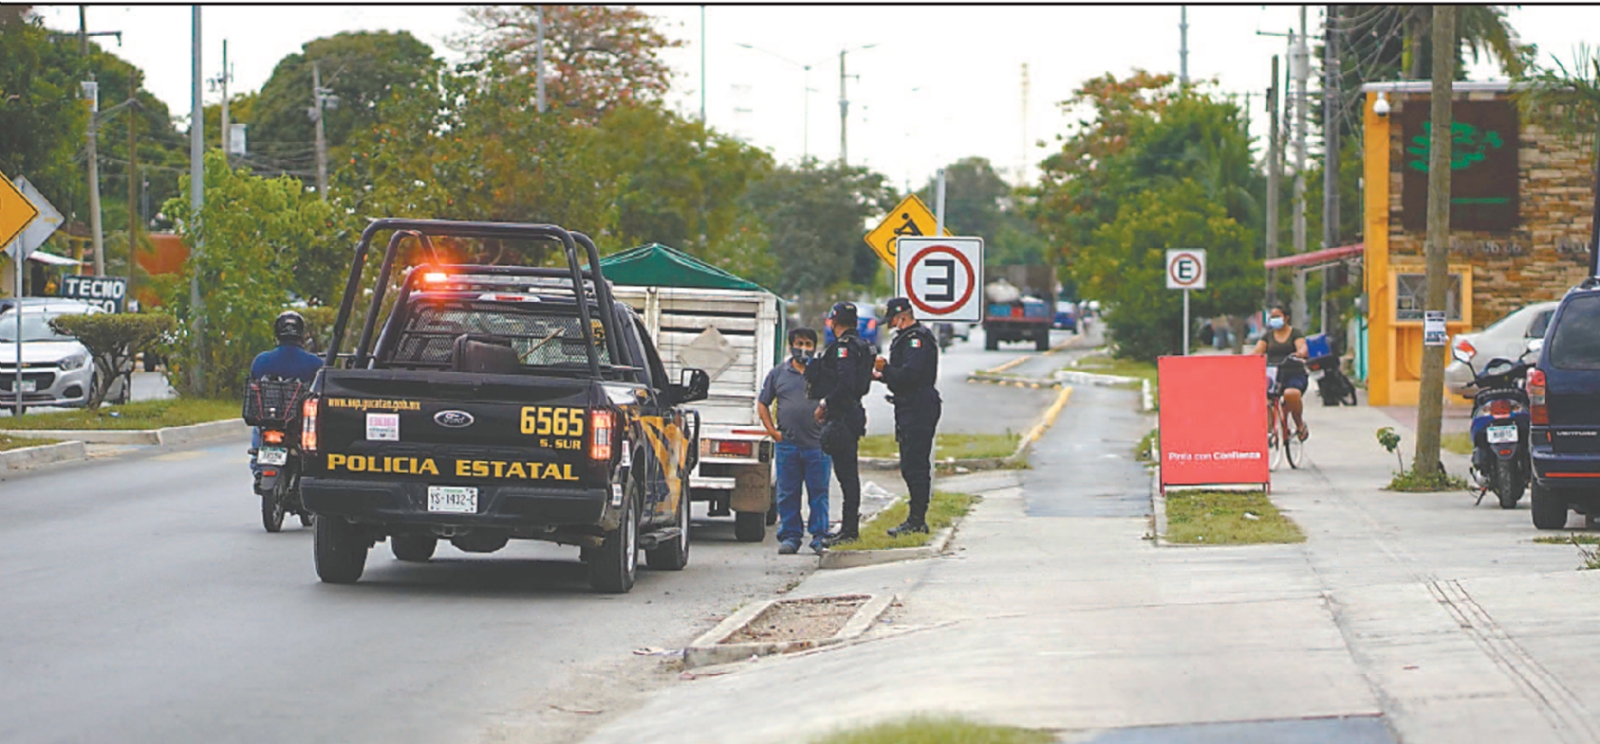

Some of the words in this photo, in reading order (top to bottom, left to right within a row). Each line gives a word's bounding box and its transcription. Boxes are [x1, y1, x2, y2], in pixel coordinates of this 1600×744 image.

[1178, 260, 1192, 279] E
[65, 279, 124, 299] TECNO
[520, 406, 585, 437] 6565
[539, 438, 552, 449] S.
[555, 439, 582, 450] SUR
[327, 453, 440, 476] POLICIA
[455, 459, 580, 481] ESTATAL
